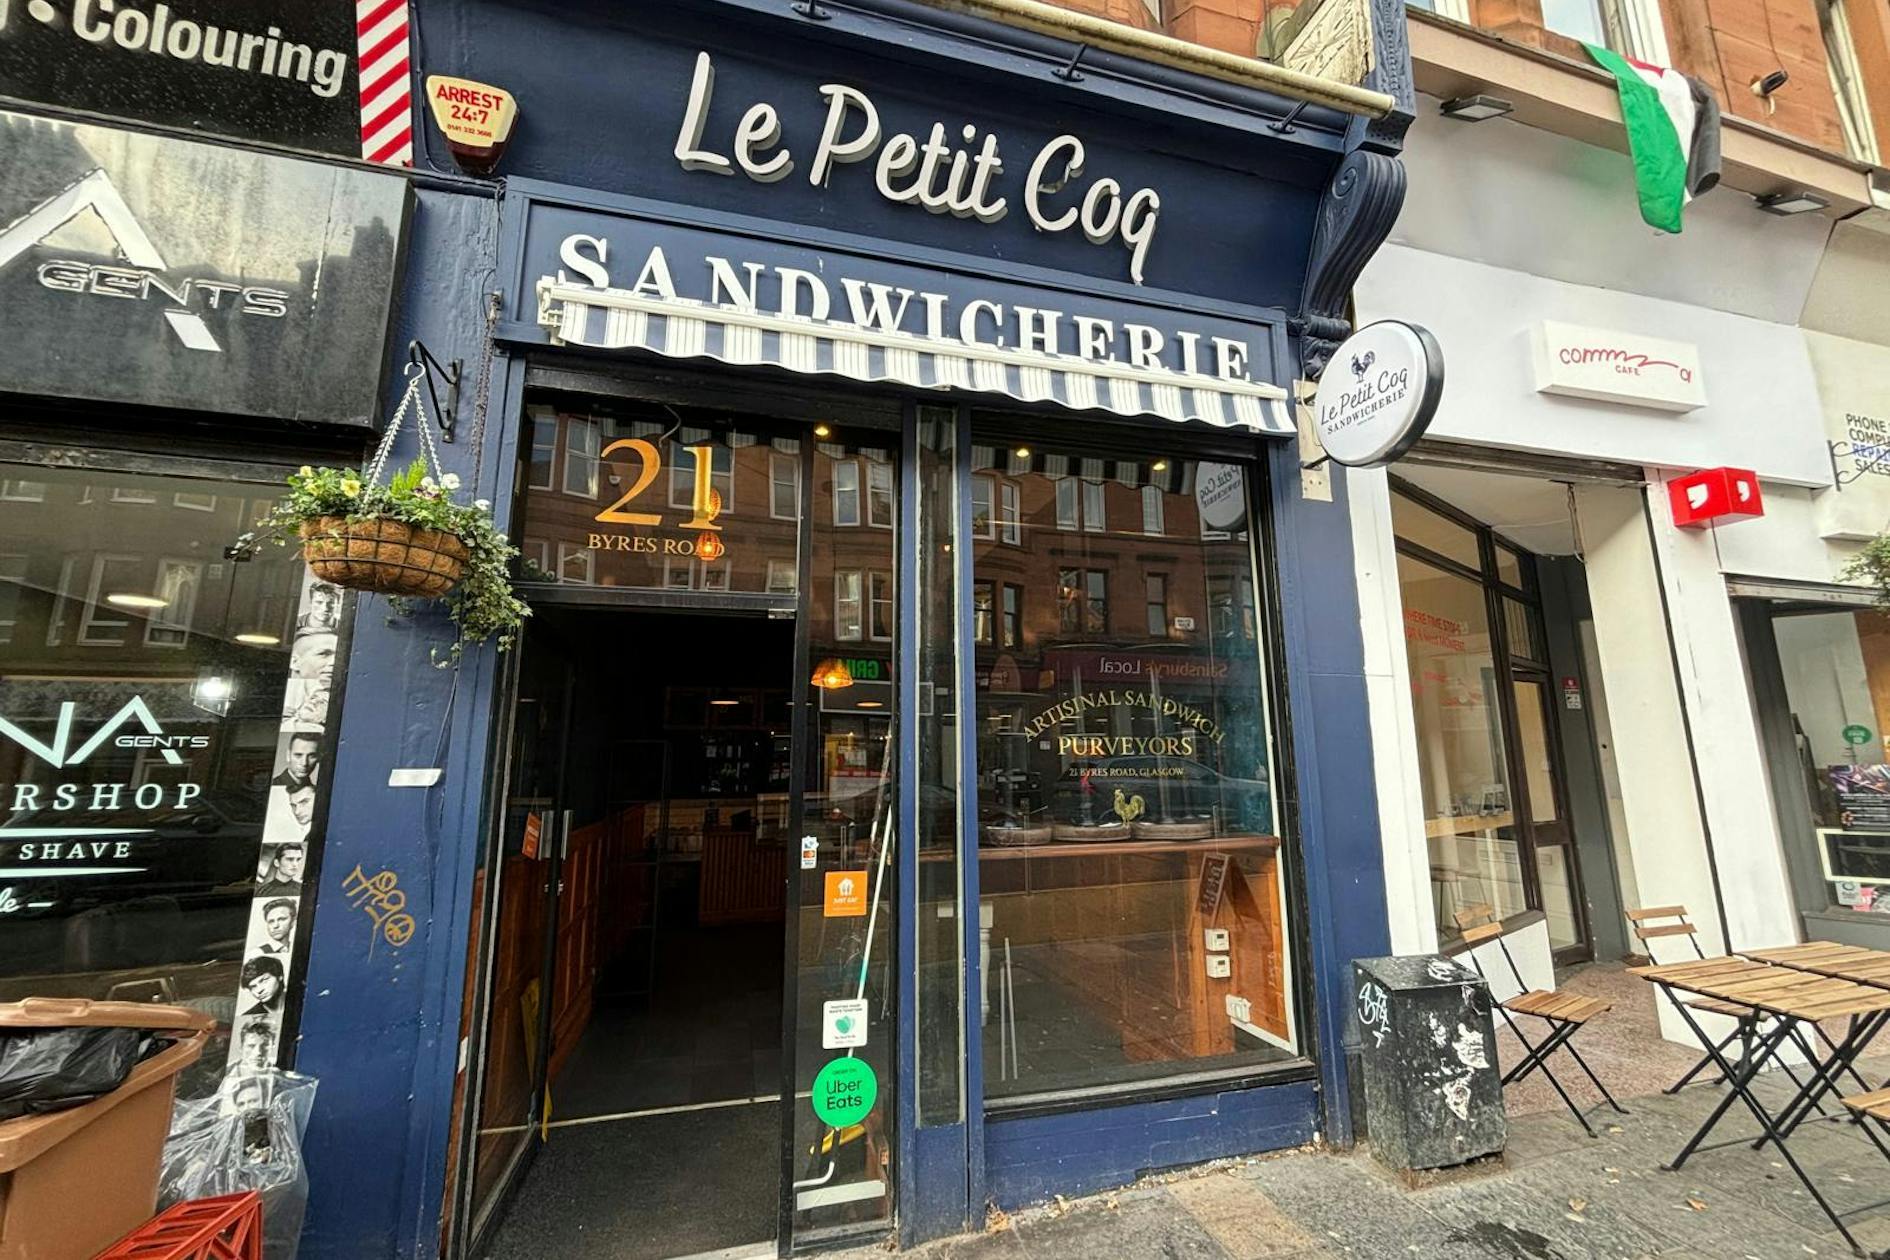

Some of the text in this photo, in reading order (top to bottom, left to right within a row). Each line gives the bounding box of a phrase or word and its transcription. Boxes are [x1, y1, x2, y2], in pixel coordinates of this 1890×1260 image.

[73, 0, 347, 98] Colouring
[436, 84, 504, 111] ARREST
[450, 104, 489, 124] 24:7
[673, 51, 1161, 285] Le Petit Coq
[37, 260, 290, 318] GENTS
[558, 233, 1251, 383] SANDWICHERIE
[1320, 367, 1408, 426] Le Petit Coq
[1327, 387, 1406, 435] SANDWICHERIE
[1845, 412, 1888, 433] PHONE
[594, 438, 723, 530] 21
[586, 532, 658, 553] BYRES
[1023, 690, 1226, 744] ARTISINAL SANDWICH
[114, 735, 210, 748] GENTS
[1057, 735, 1194, 756] PURVEYORS
[1080, 767, 1108, 777] BYRES
[1139, 767, 1184, 777] GLASGOW
[19, 841, 131, 861] SHAVE
[826, 1079, 862, 1095] Uber
[826, 1095, 863, 1110] Eats
